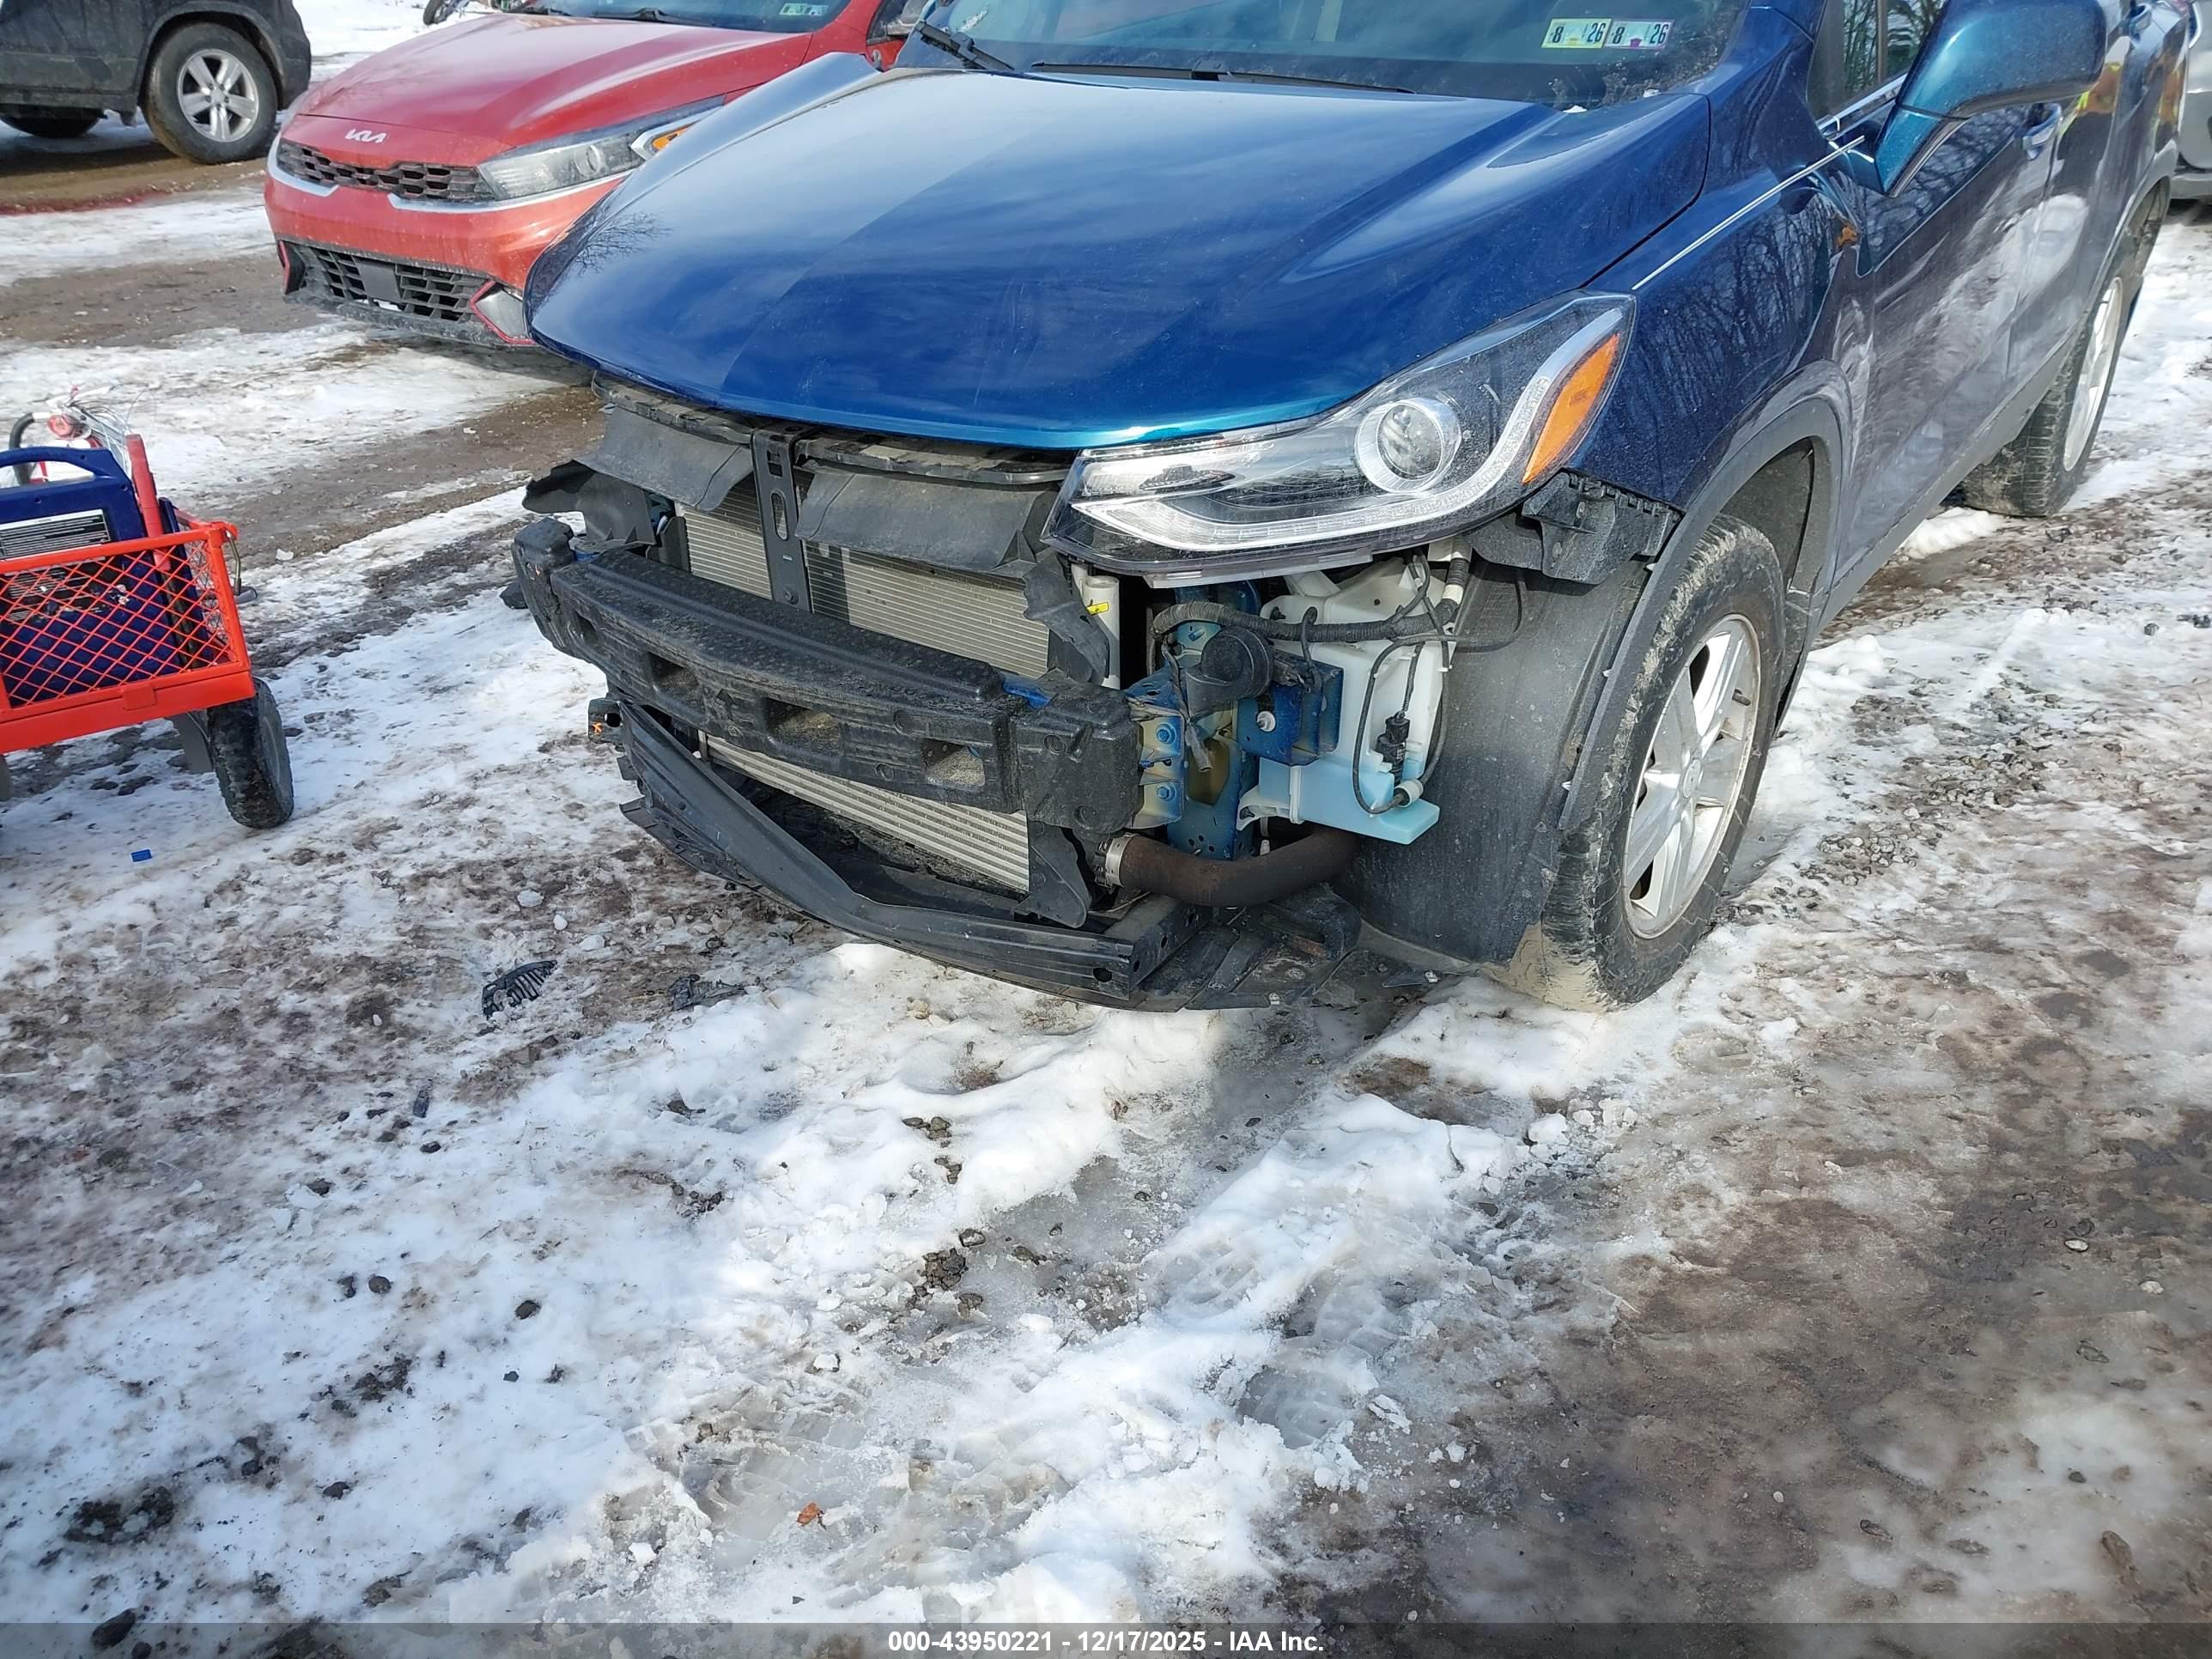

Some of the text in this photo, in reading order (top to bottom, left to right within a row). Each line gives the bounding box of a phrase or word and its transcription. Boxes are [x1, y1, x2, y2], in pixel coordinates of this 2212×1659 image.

[1587, 22, 1607, 43] 26
[1649, 23, 1669, 44] 26
[344, 129, 386, 143] KIA
